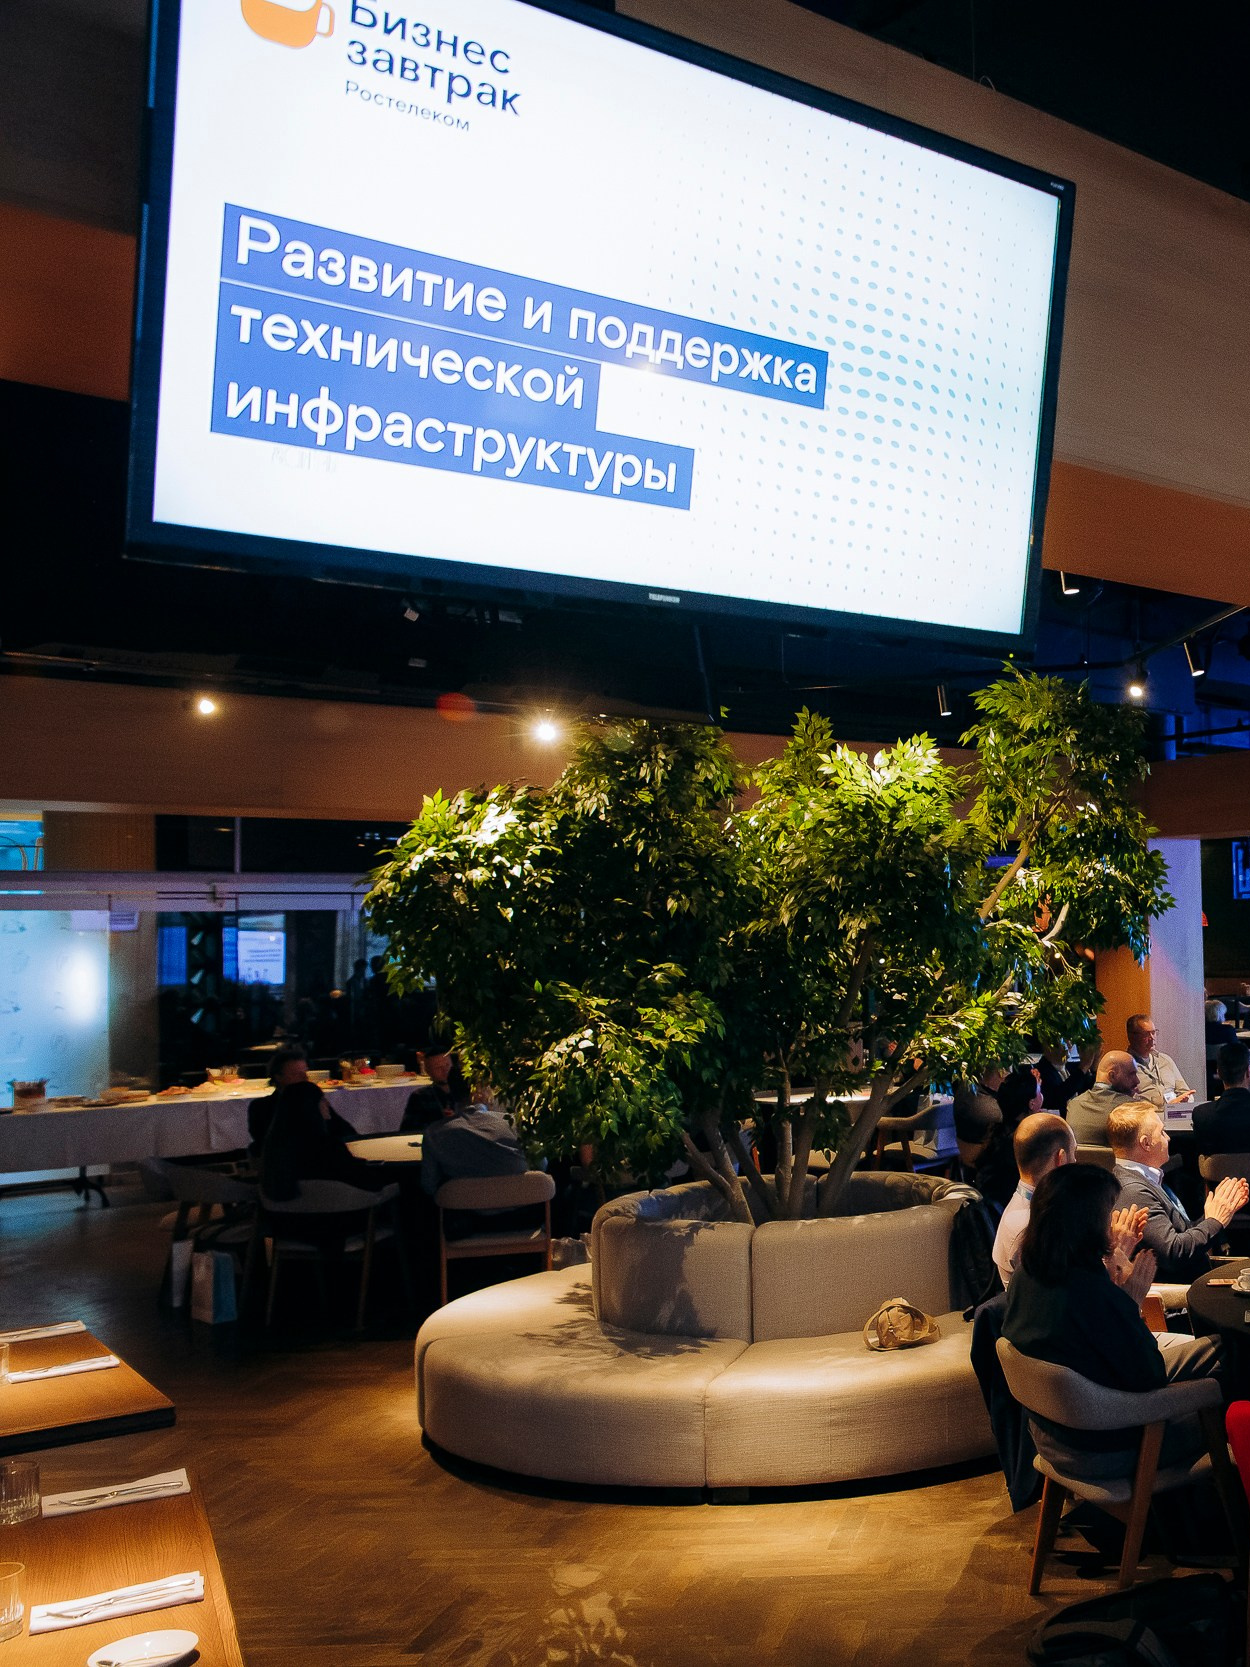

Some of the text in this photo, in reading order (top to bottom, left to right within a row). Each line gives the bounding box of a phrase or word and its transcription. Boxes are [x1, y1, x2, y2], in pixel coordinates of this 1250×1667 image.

[347, 40, 521, 117] завтрак
[350, 0, 511, 74] Бизнес
[345, 80, 470, 132] Ростелеком
[236, 214, 818, 395] Развитие и поддержка
[230, 304, 586, 410] технической
[226, 381, 678, 495] инфраструктуры
